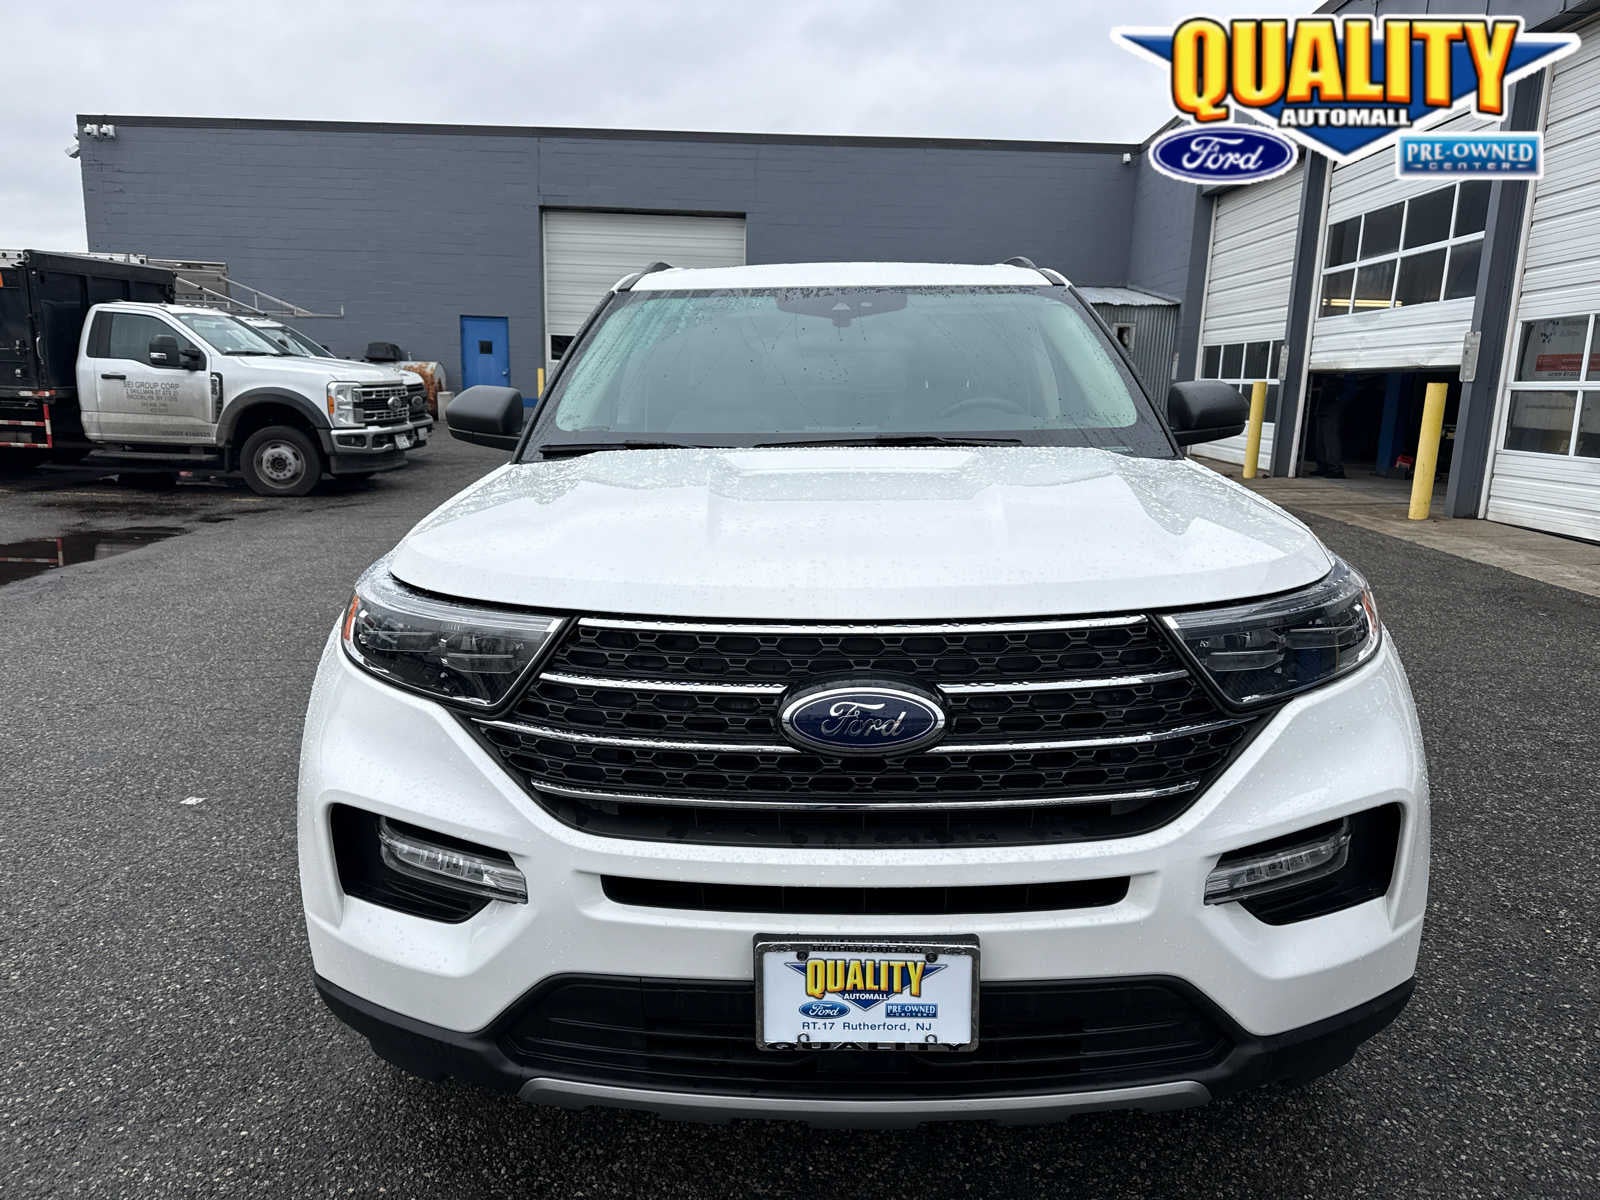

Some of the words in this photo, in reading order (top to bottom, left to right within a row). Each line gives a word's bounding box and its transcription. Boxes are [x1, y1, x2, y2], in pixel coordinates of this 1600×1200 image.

[821, 701, 907, 737] Ford
[806, 958, 926, 999] QUALITY
[843, 993, 889, 1001] AUTOMALL
[808, 1003, 840, 1016] Ford
[887, 1005, 936, 1014] PRE-OWNED
[802, 1022, 835, 1031] RT.17
[843, 1022, 911, 1032] Rutherford,
[916, 1022, 932, 1031] NJ
